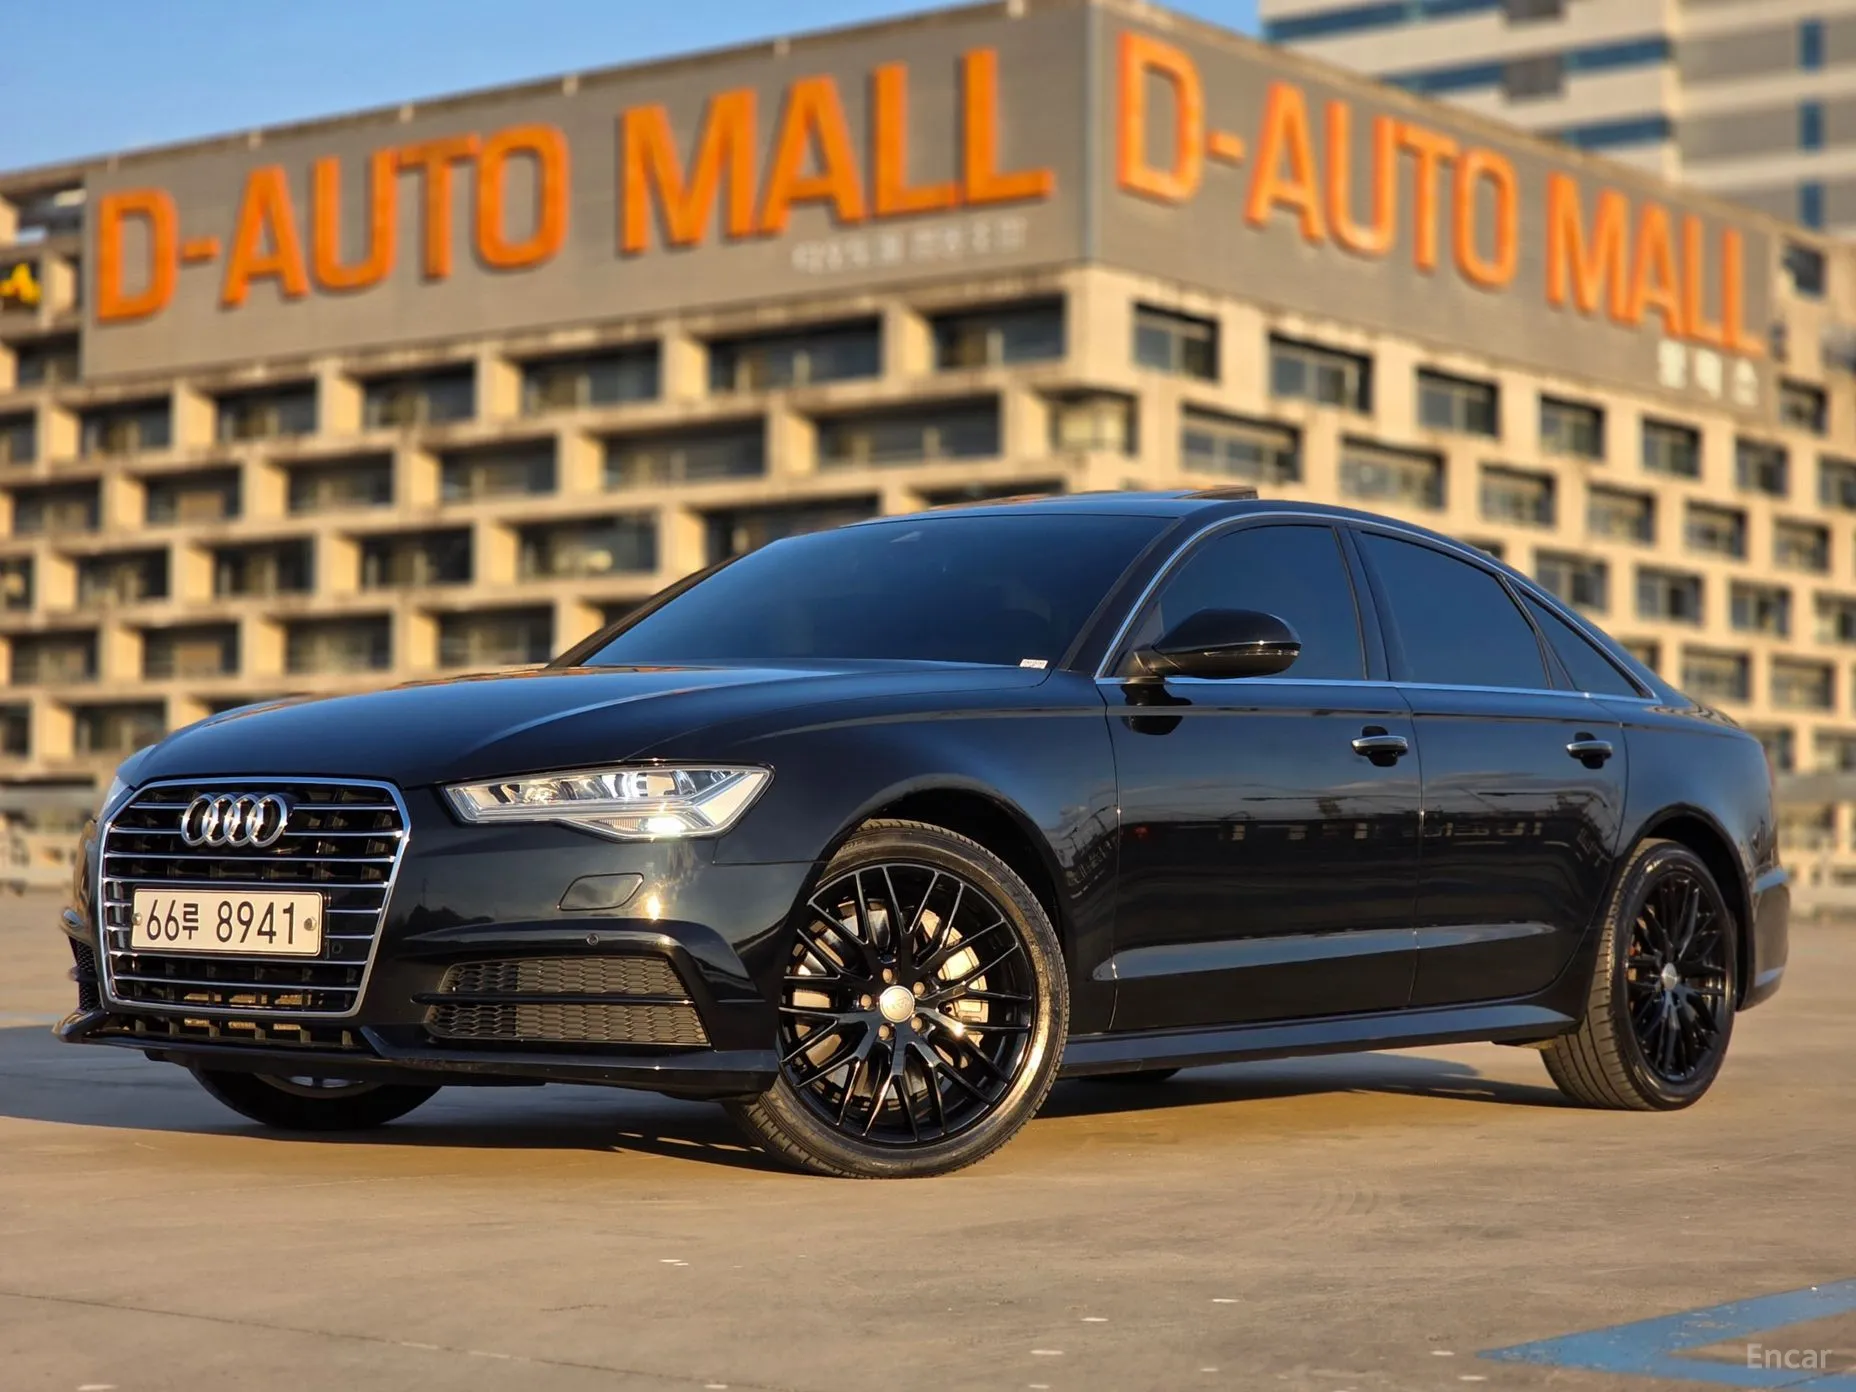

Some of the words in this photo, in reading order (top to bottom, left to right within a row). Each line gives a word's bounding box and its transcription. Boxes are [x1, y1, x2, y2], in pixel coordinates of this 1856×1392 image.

[97, 122, 569, 324] D-AUTO
[619, 48, 1054, 254] MALL
[1117, 30, 1519, 290] D-AUTO
[1545, 171, 1766, 358] MALL
[147, 899, 199, 941] 66루
[216, 900, 295, 945] 8941
